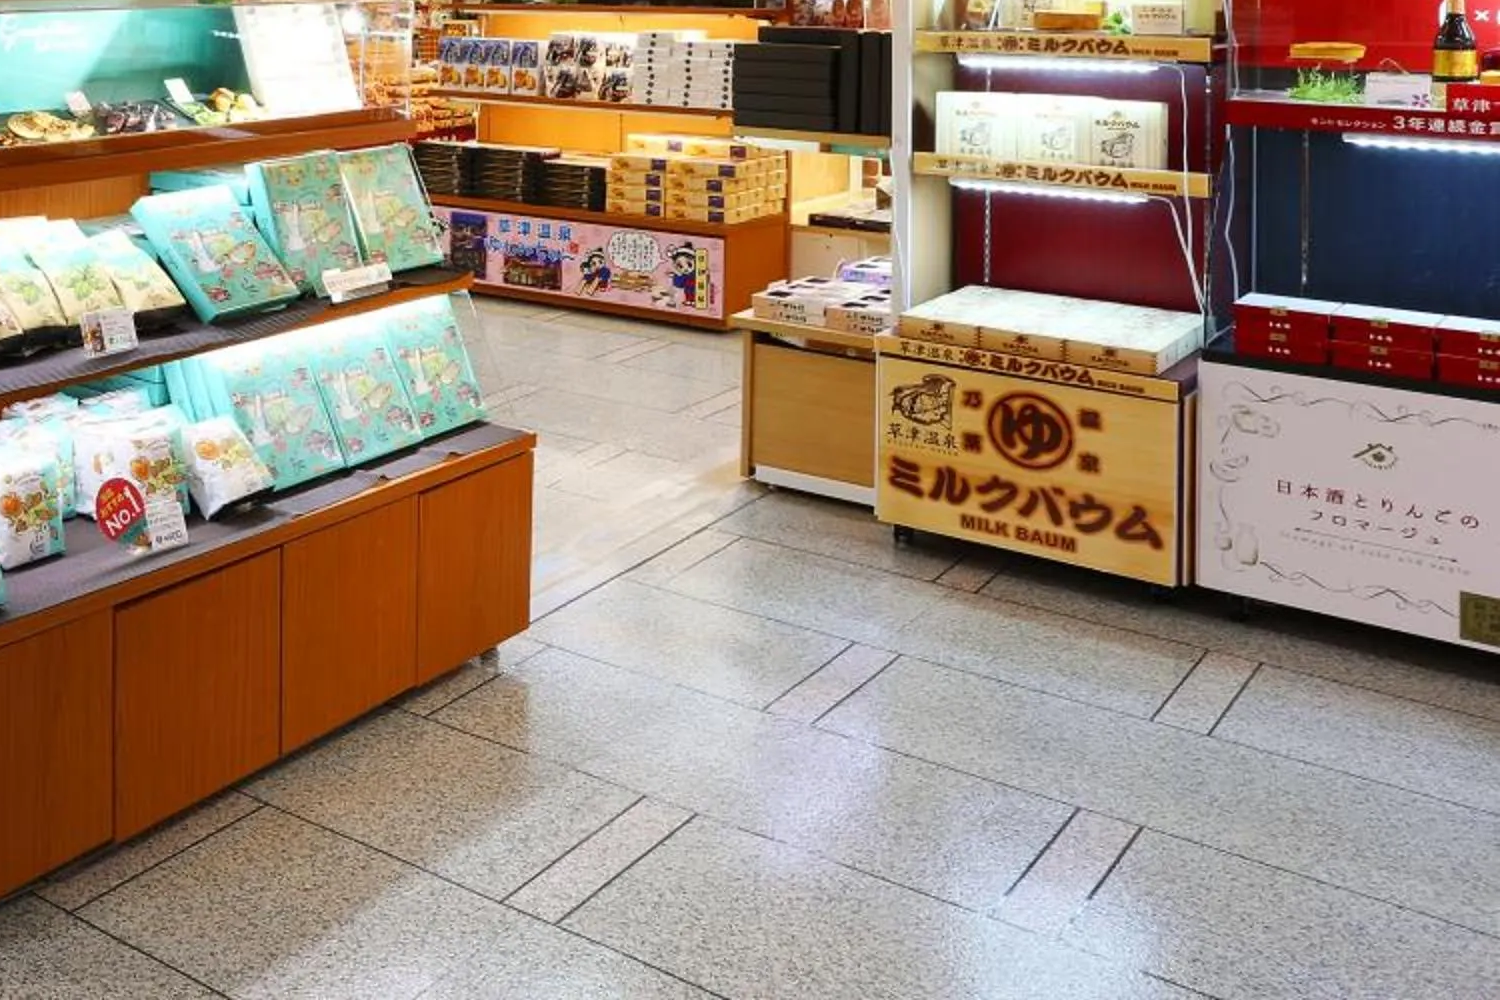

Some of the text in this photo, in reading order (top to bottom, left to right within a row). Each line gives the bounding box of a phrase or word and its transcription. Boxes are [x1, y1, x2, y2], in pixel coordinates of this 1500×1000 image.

[1026, 39, 1130, 56] ミルクバウム
[1025, 166, 1128, 189] ミルクバウム
[988, 356, 1095, 386] ミルクバウム
[995, 397, 1068, 463] ゆ
[104, 485, 142, 537] NO.1
[887, 455, 1165, 551] ミルクバウム
[1276, 479, 1480, 529] 日本酒とりんごの
[960, 514, 1078, 553] MILK BAUM
[1310, 510, 1442, 546] フロマージュ
